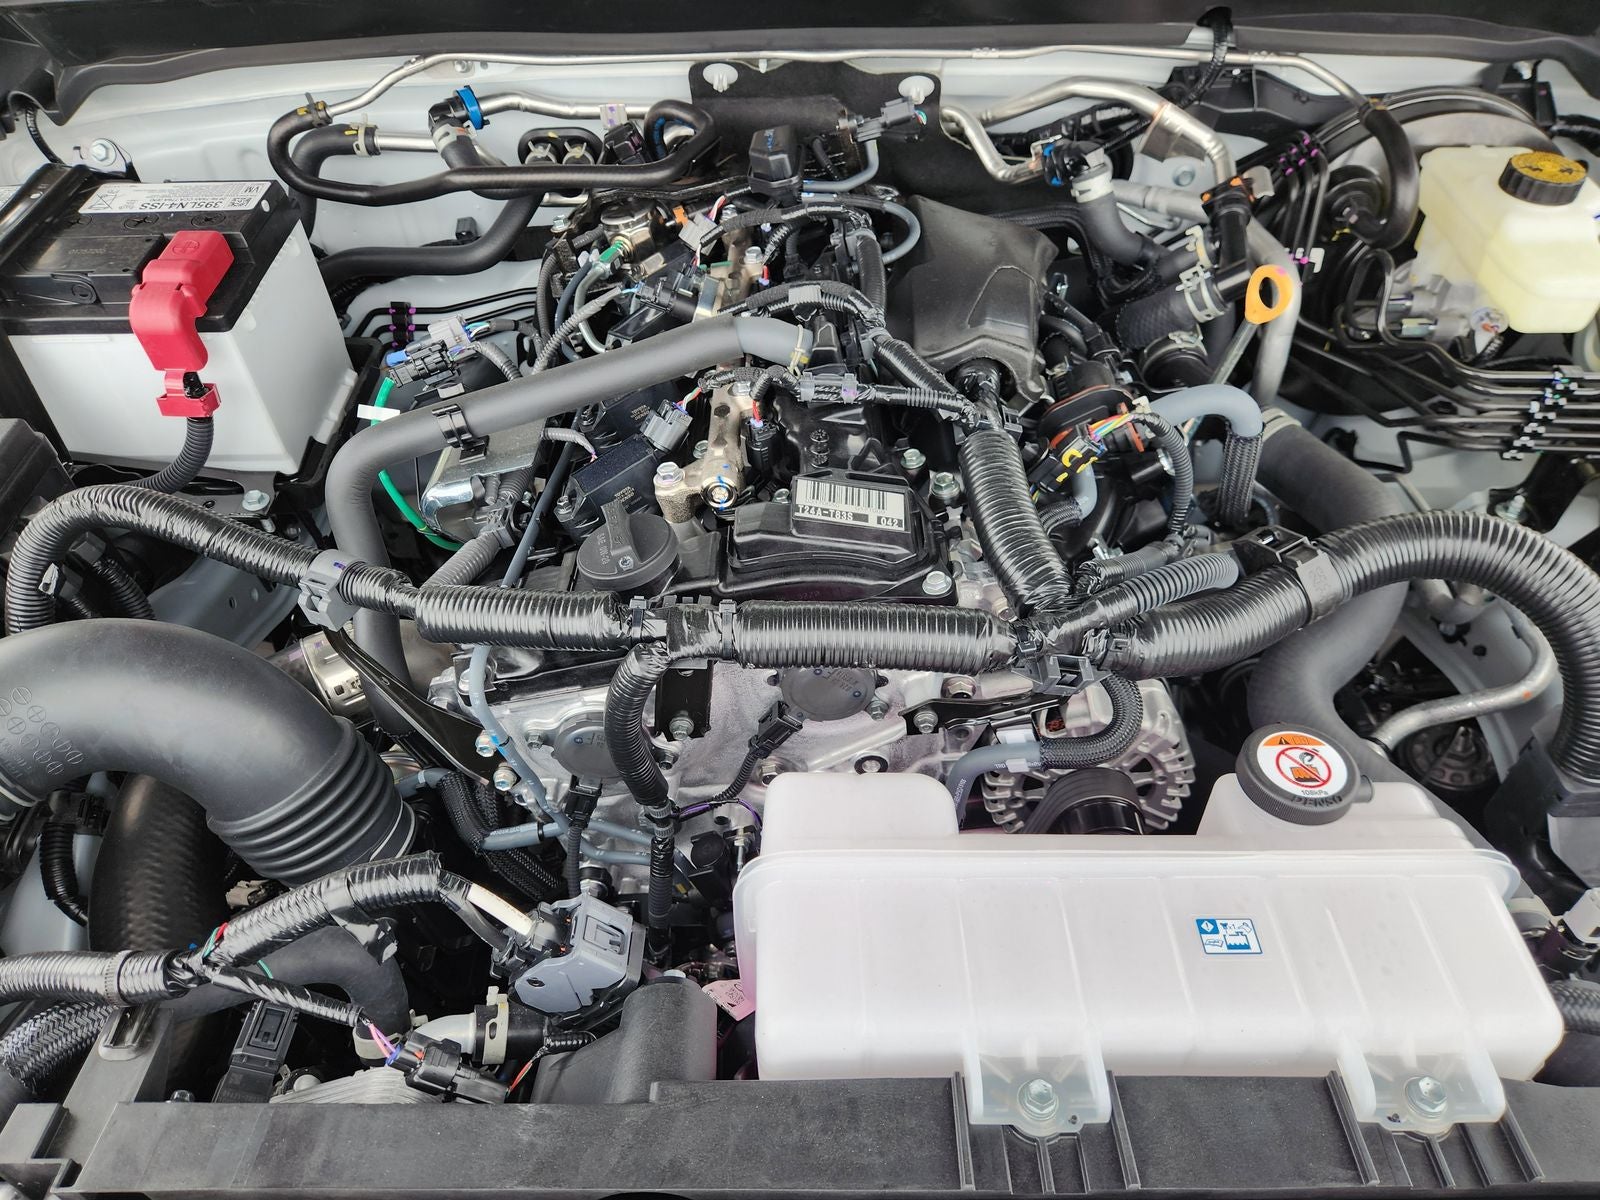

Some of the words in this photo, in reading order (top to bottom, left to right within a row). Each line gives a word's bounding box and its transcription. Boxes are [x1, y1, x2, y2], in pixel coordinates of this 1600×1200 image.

[139, 200, 223, 210] 395LN4-ISS
[798, 504, 854, 521] T24A-T83S
[880, 517, 899, 527] 042
[1291, 795, 1344, 808] DENSO
